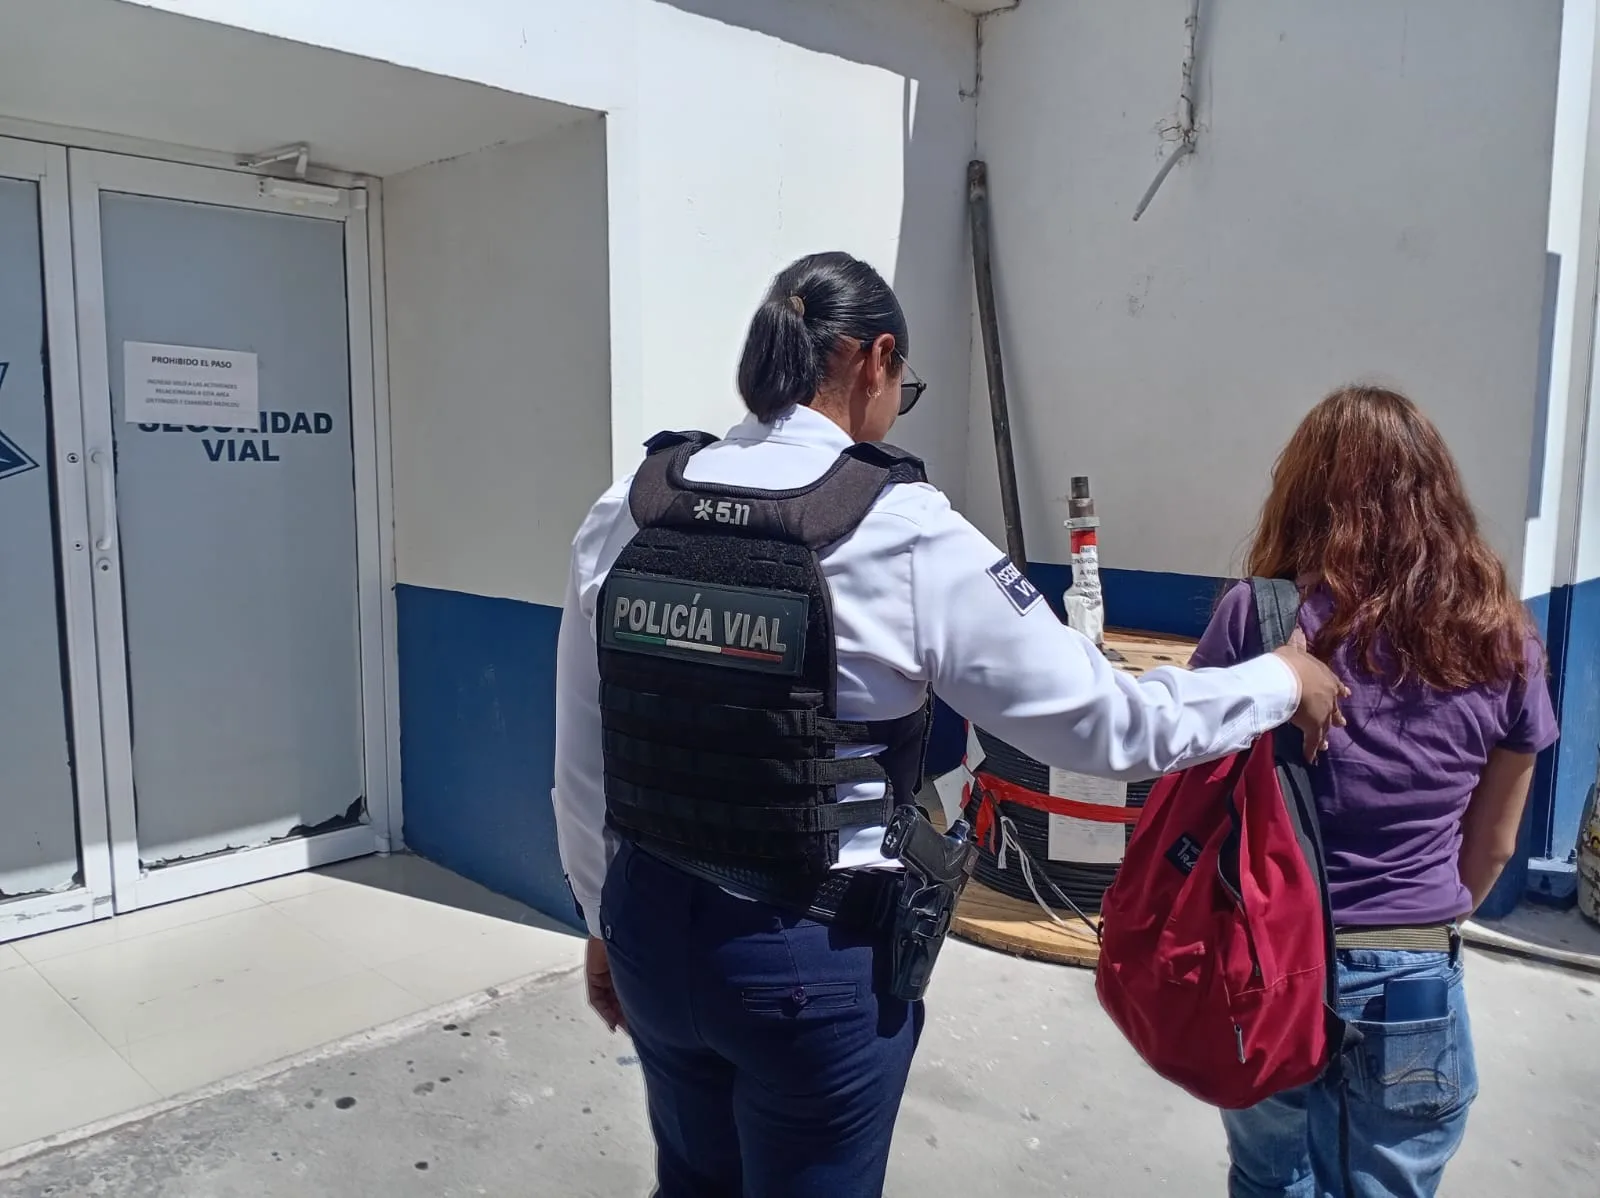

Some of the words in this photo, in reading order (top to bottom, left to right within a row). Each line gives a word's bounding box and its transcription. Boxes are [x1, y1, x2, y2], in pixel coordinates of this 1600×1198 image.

[151, 356, 199, 366] PROHIBIDO
[200, 359, 209, 367] EL
[211, 360, 232, 369] PASO
[202, 439, 280, 462] VIAL
[715, 501, 750, 526] 5.11
[613, 592, 713, 642] POLICÍA
[723, 611, 787, 653] VIAL
